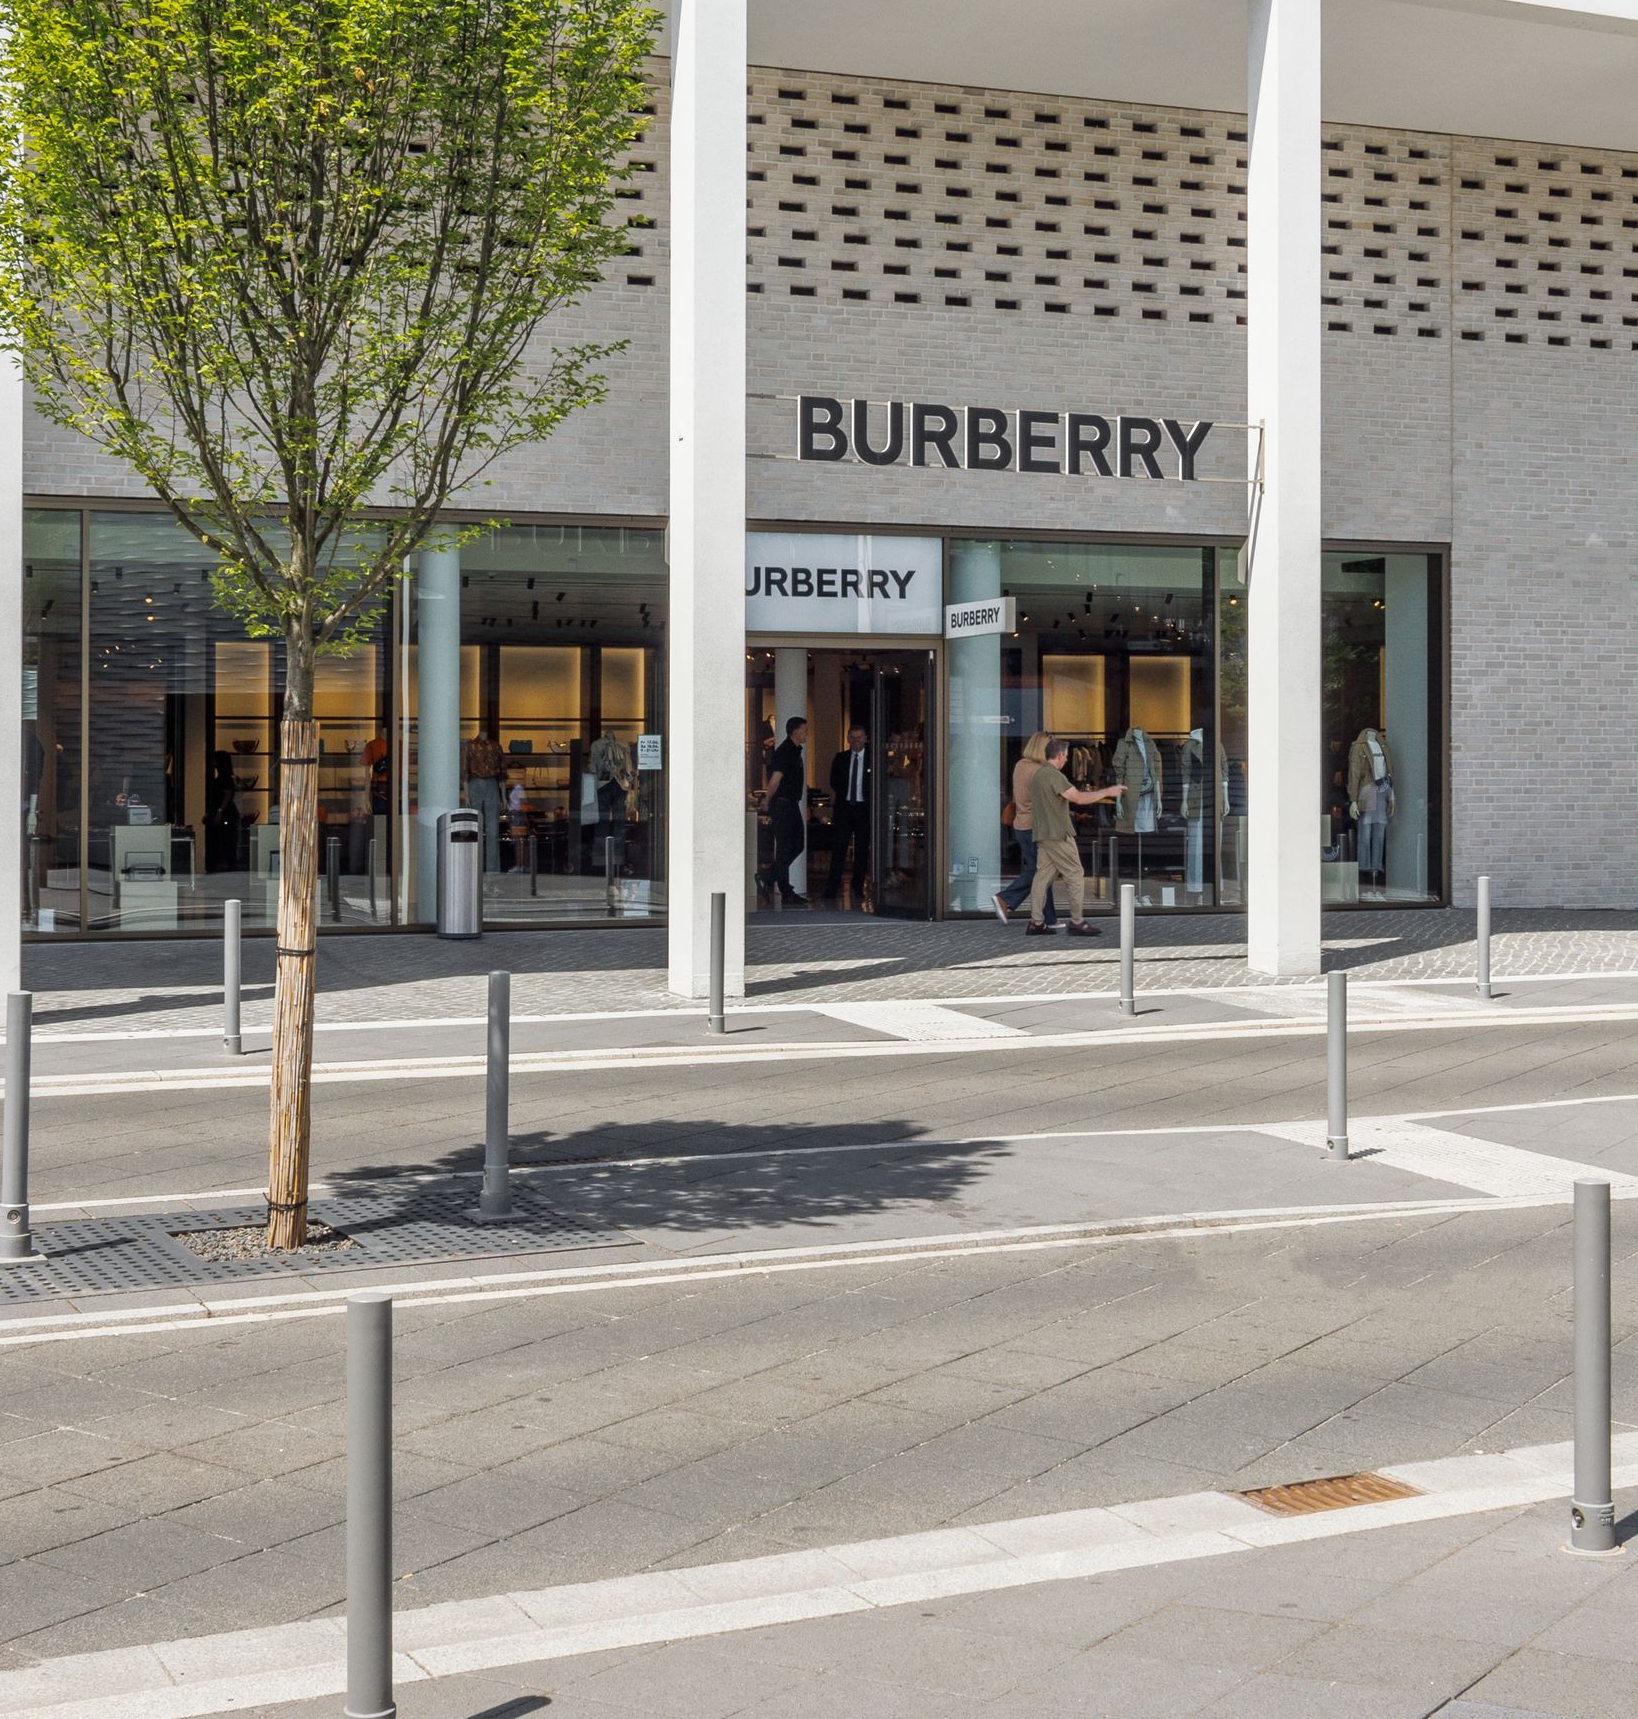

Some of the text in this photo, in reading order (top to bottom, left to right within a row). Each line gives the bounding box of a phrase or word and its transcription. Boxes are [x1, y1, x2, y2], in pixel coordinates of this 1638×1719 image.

[797, 395, 1214, 481] BURBERRY
[745, 566, 916, 599] URBERRY
[950, 607, 1001, 629] BURBERRY
